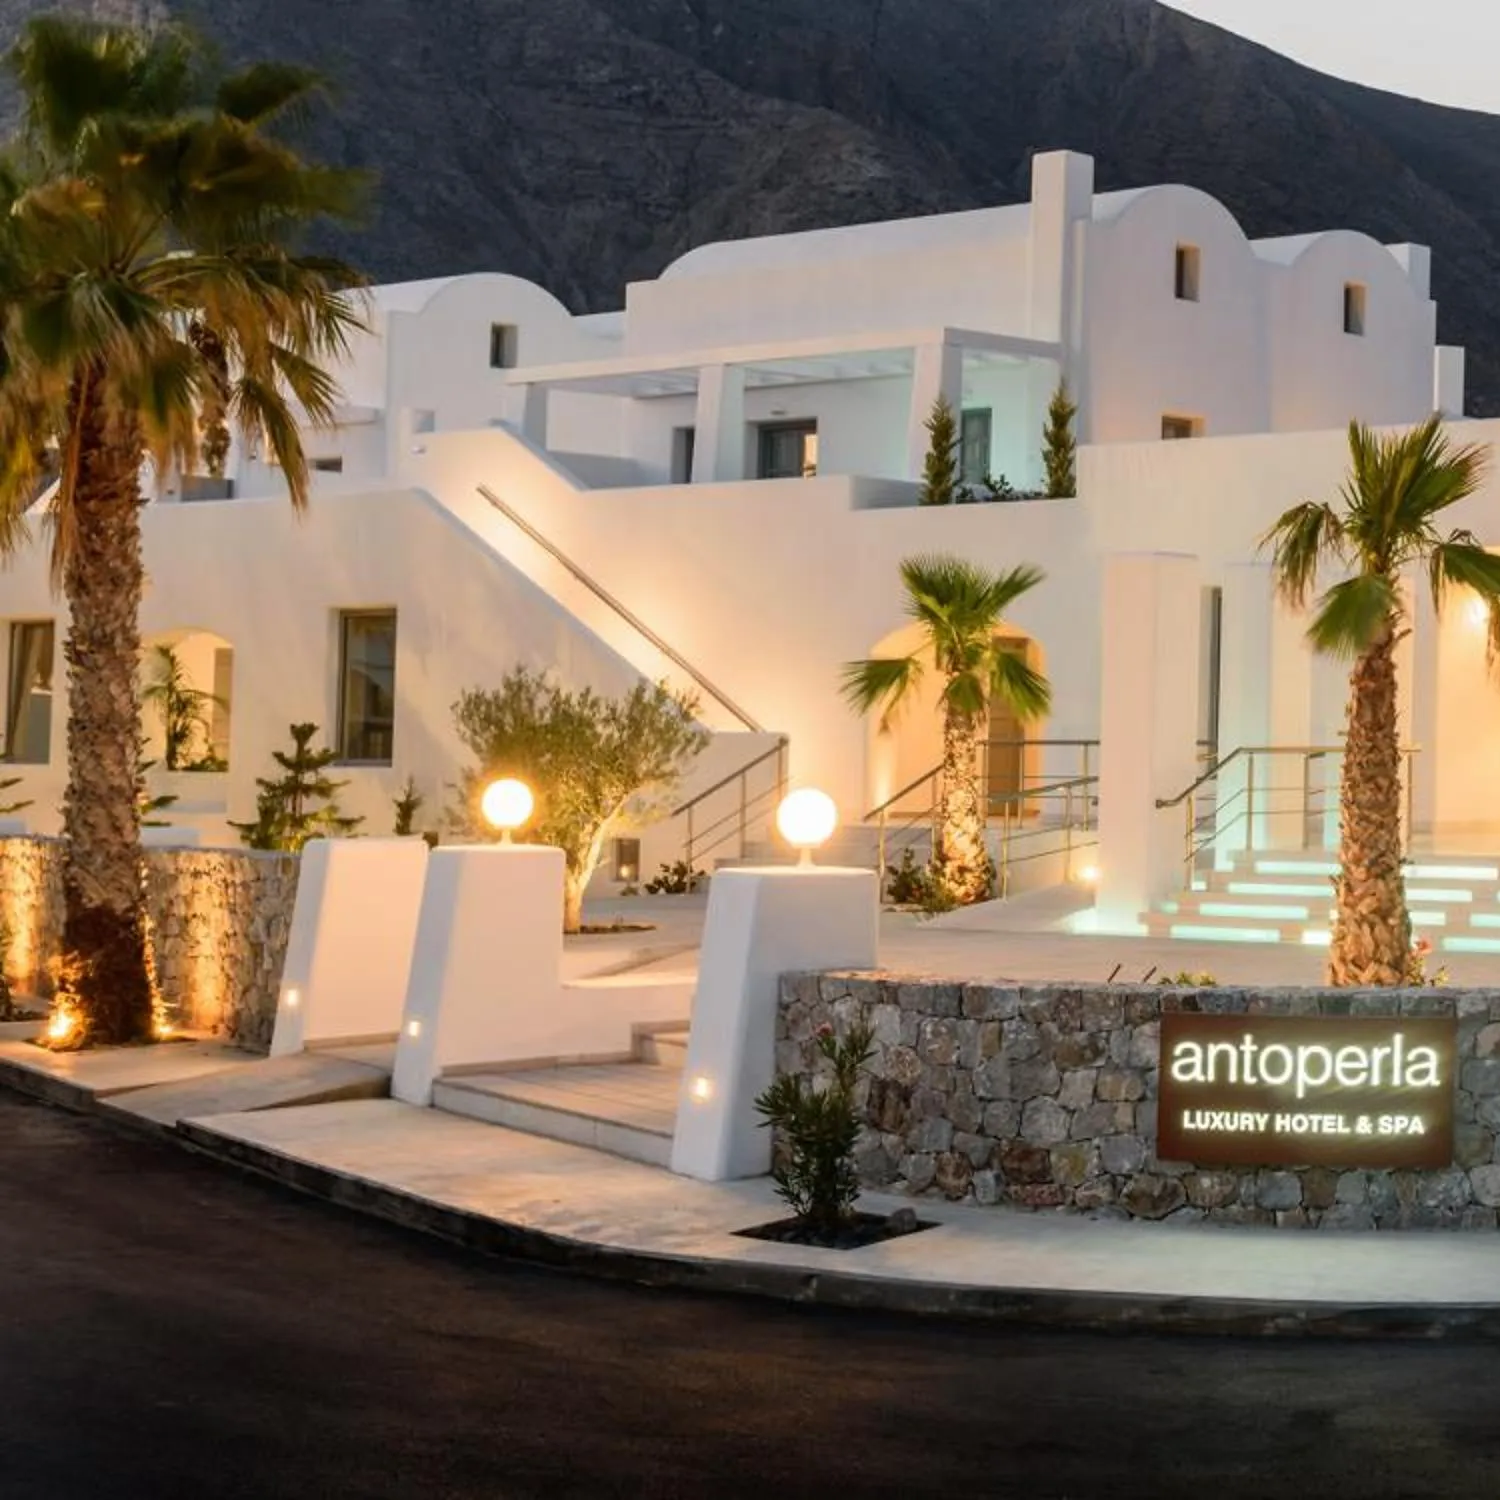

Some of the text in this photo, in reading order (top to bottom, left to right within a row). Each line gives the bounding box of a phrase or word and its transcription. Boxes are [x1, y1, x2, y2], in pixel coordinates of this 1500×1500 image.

[1171, 1033, 1441, 1099] antoperla
[1182, 1110, 1426, 1135] LUXURY HOTEL & SPA
